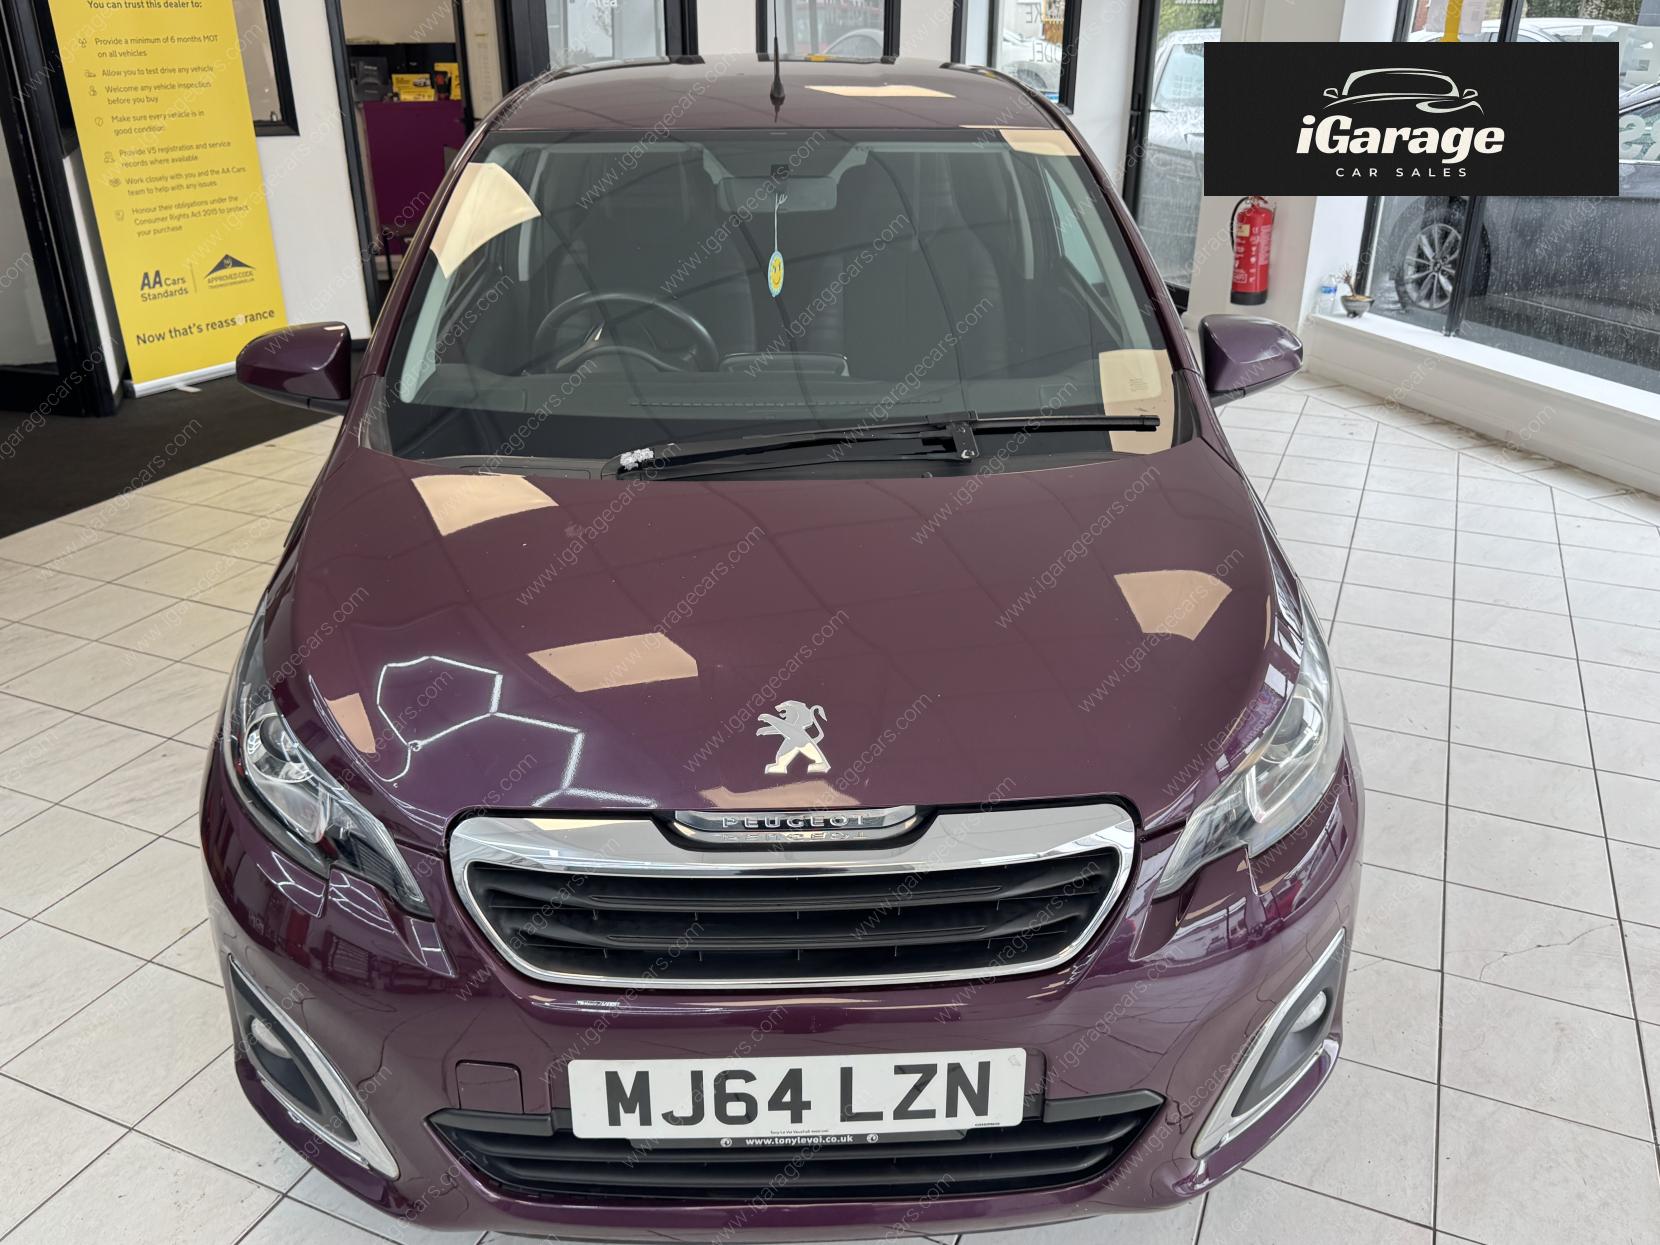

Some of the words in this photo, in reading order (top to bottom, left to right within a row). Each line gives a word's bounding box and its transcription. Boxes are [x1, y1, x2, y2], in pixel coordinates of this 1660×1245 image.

[88, 0, 104, 8] You
[125, 0, 144, 8] trust
[147, 0, 161, 8] this
[164, 0, 189, 8] dealer
[95, 37, 123, 46] Provide
[177, 35, 201, 43] months
[102, 69, 121, 77] Allow
[160, 66, 177, 74] drive
[105, 85, 138, 93] Welcome
[153, 82, 176, 90] vehicle
[178, 80, 211, 90] inspection
[146, 95, 158, 103] buy
[149, 113, 167, 121] every
[114, 127, 132, 135] good
[119, 149, 145, 157] Provide
[158, 144, 193, 154] registration
[122, 160, 148, 168] records
[125, 177, 144, 185] Work
[146, 174, 168, 183] closely
[232, 166, 245, 174] Cars
[128, 188, 145, 196] team
[155, 185, 168, 194] help
[170, 183, 184, 191] with
[132, 207, 157, 215] Honour
[175, 200, 208, 210] obligations
[210, 197, 227, 205] under
[134, 216, 168, 225] Consumer
[169, 213, 189, 222] Rights
[191, 211, 200, 219] Act
[227, 205, 248, 213] protect
[137, 230, 151, 238] your
[140, 270, 162, 290] AA
[164, 277, 186, 286] Cars
[141, 287, 189, 302] Standards
[136, 332, 165, 345] Now
[169, 323, 203, 339] that's
[722, 815, 864, 828] PEUGEOT
[604, 1067, 811, 1127] MJ64
[840, 1061, 991, 1123] LZN
[746, 1134, 854, 1146] www.tonylevoi.co.uk
